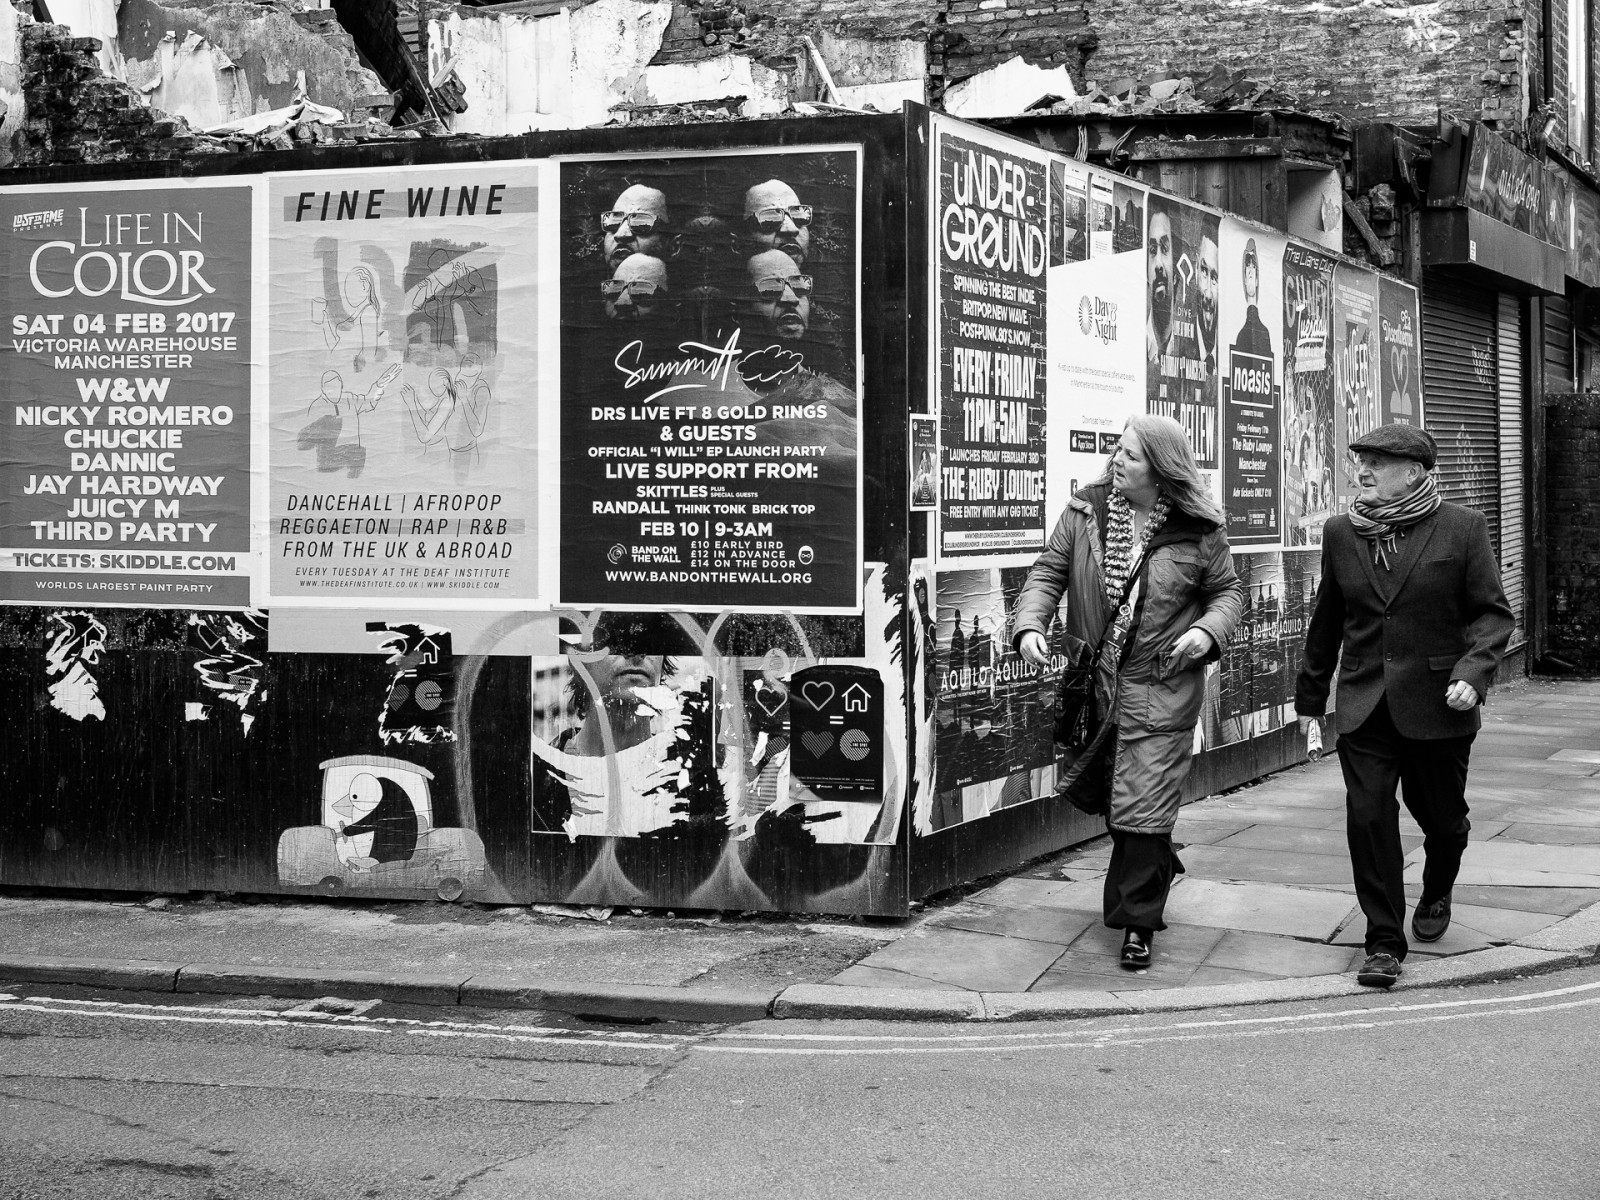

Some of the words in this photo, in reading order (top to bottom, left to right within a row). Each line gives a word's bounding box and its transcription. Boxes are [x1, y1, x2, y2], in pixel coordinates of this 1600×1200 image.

[295, 189, 386, 222] FINE
[407, 184, 507, 218] WINE
[78, 207, 153, 247] LIFE
[163, 212, 202, 244] IN
[29, 240, 217, 306] COLOR
[953, 274, 988, 296] SPINNING
[988, 281, 1001, 299] THE
[1002, 284, 1017, 302] BEST
[12, 314, 64, 335] SAT
[73, 314, 106, 334] 04
[115, 313, 167, 333] FEB
[176, 312, 236, 333] 2017
[1095, 319, 1118, 346] Night
[12, 338, 101, 353] VICTORIA
[105, 336, 237, 351] WAREHOUSE
[54, 354, 193, 369] MANCHESTER
[953, 346, 992, 395] EVERY
[994, 352, 1037, 399] FRIDAY
[1233, 363, 1271, 396] noasis
[76, 377, 171, 403] W&W
[15, 406, 101, 426] NICKY
[108, 405, 233, 426] ROMERO
[591, 406, 626, 421] DRS
[631, 406, 670, 421] LIVE
[675, 406, 697, 420] FT
[701, 406, 712, 420] 8
[717, 405, 767, 420] GOLD
[771, 405, 828, 420] RINGS
[962, 397, 1028, 445] 11PM-5AM
[63, 429, 183, 449] CHUCKIE
[660, 426, 674, 442] &
[678, 425, 757, 441] GUESTS
[588, 446, 648, 458] OFFICIAL
[706, 446, 723, 457] EP
[726, 446, 781, 457] LAUNCH
[783, 445, 828, 457] PARTY
[1232, 437, 1242, 451] The
[1242, 438, 1256, 454] Ruby
[1255, 439, 1273, 455] Lounge
[71, 452, 176, 472] DANNIC
[949, 448, 980, 462] LAUNCHES
[981, 449, 1000, 463] FRIDAY
[1001, 450, 1028, 464] FEBRUARY
[1028, 452, 1040, 464] 3RD
[1238, 456, 1267, 471] Manchester
[605, 463, 650, 479] LIVE
[654, 463, 750, 479] SUPPORT
[754, 463, 819, 479] FROM:
[23, 474, 74, 495] JAY
[80, 475, 225, 496] HARDWAY
[636, 485, 708, 498] SKITTLES
[942, 466, 965, 500] THE
[968, 467, 1000, 501] RUBY
[1003, 469, 1045, 502] LOUNGE
[67, 498, 147, 518] JUICY
[154, 499, 180, 519] M
[287, 494, 394, 511] DANCEHALL
[413, 494, 502, 511] AFROPOP
[592, 501, 670, 515] RANDALL
[675, 504, 711, 514] THINK
[713, 504, 747, 514] TONK
[752, 504, 788, 514] BRICK
[791, 504, 816, 514] TOP
[949, 505, 963, 519] FREE
[963, 505, 981, 519] ENTRY
[982, 505, 996, 518] WITH
[997, 505, 1009, 518] ANY
[1009, 505, 1021, 518] GIG
[1021, 505, 1040, 518] TICKET
[30, 521, 113, 541] THIRD
[120, 522, 218, 543] PARTY
[280, 518, 391, 535] REGGAETON
[411, 518, 449, 535] RAP
[470, 518, 508, 535] R&B
[640, 521, 676, 537] FEB
[679, 521, 700, 537] 10
[714, 521, 773, 537] 9-3AM
[283, 541, 334, 558] FROM
[343, 541, 378, 558] THE
[384, 541, 409, 558] UK
[416, 541, 428, 559] &
[435, 542, 513, 559] ABROAD
[631, 546, 659, 555] BAND
[661, 546, 678, 555] ON
[690, 541, 710, 549] £10
[714, 541, 751, 549] EARLY
[755, 541, 784, 549] BIRD
[12, 553, 96, 569] TICKETS:
[99, 554, 236, 571] SKIDDLE.COM
[631, 554, 650, 563] THE
[651, 554, 681, 563] WALL
[690, 550, 709, 559] £12
[713, 550, 726, 559] IN
[731, 550, 786, 559] ADVANCE
[690, 559, 710, 568] £14
[714, 559, 731, 568] ON
[735, 559, 757, 568] THE
[762, 559, 796, 568] DOOR
[295, 567, 328, 577] EVERY
[332, 567, 378, 578] TUESDAY
[382, 568, 396, 577] AT
[400, 568, 420, 578] THE
[423, 568, 450, 578] DEAF
[455, 568, 511, 579] INSTITUTE
[605, 571, 812, 584] WWW.BANDONTHEWALL.ORG
[35, 581, 83, 590] WORLDS
[86, 582, 137, 591] LARGEST
[139, 583, 173, 592] PAINT
[176, 584, 213, 593] PARTY
[299, 580, 420, 589] WWW.THEDEAFINSTITUTE.CO.UK
[427, 581, 500, 589] WWW.SKIDDLE.COM
[940, 666, 988, 691] AQUILO
